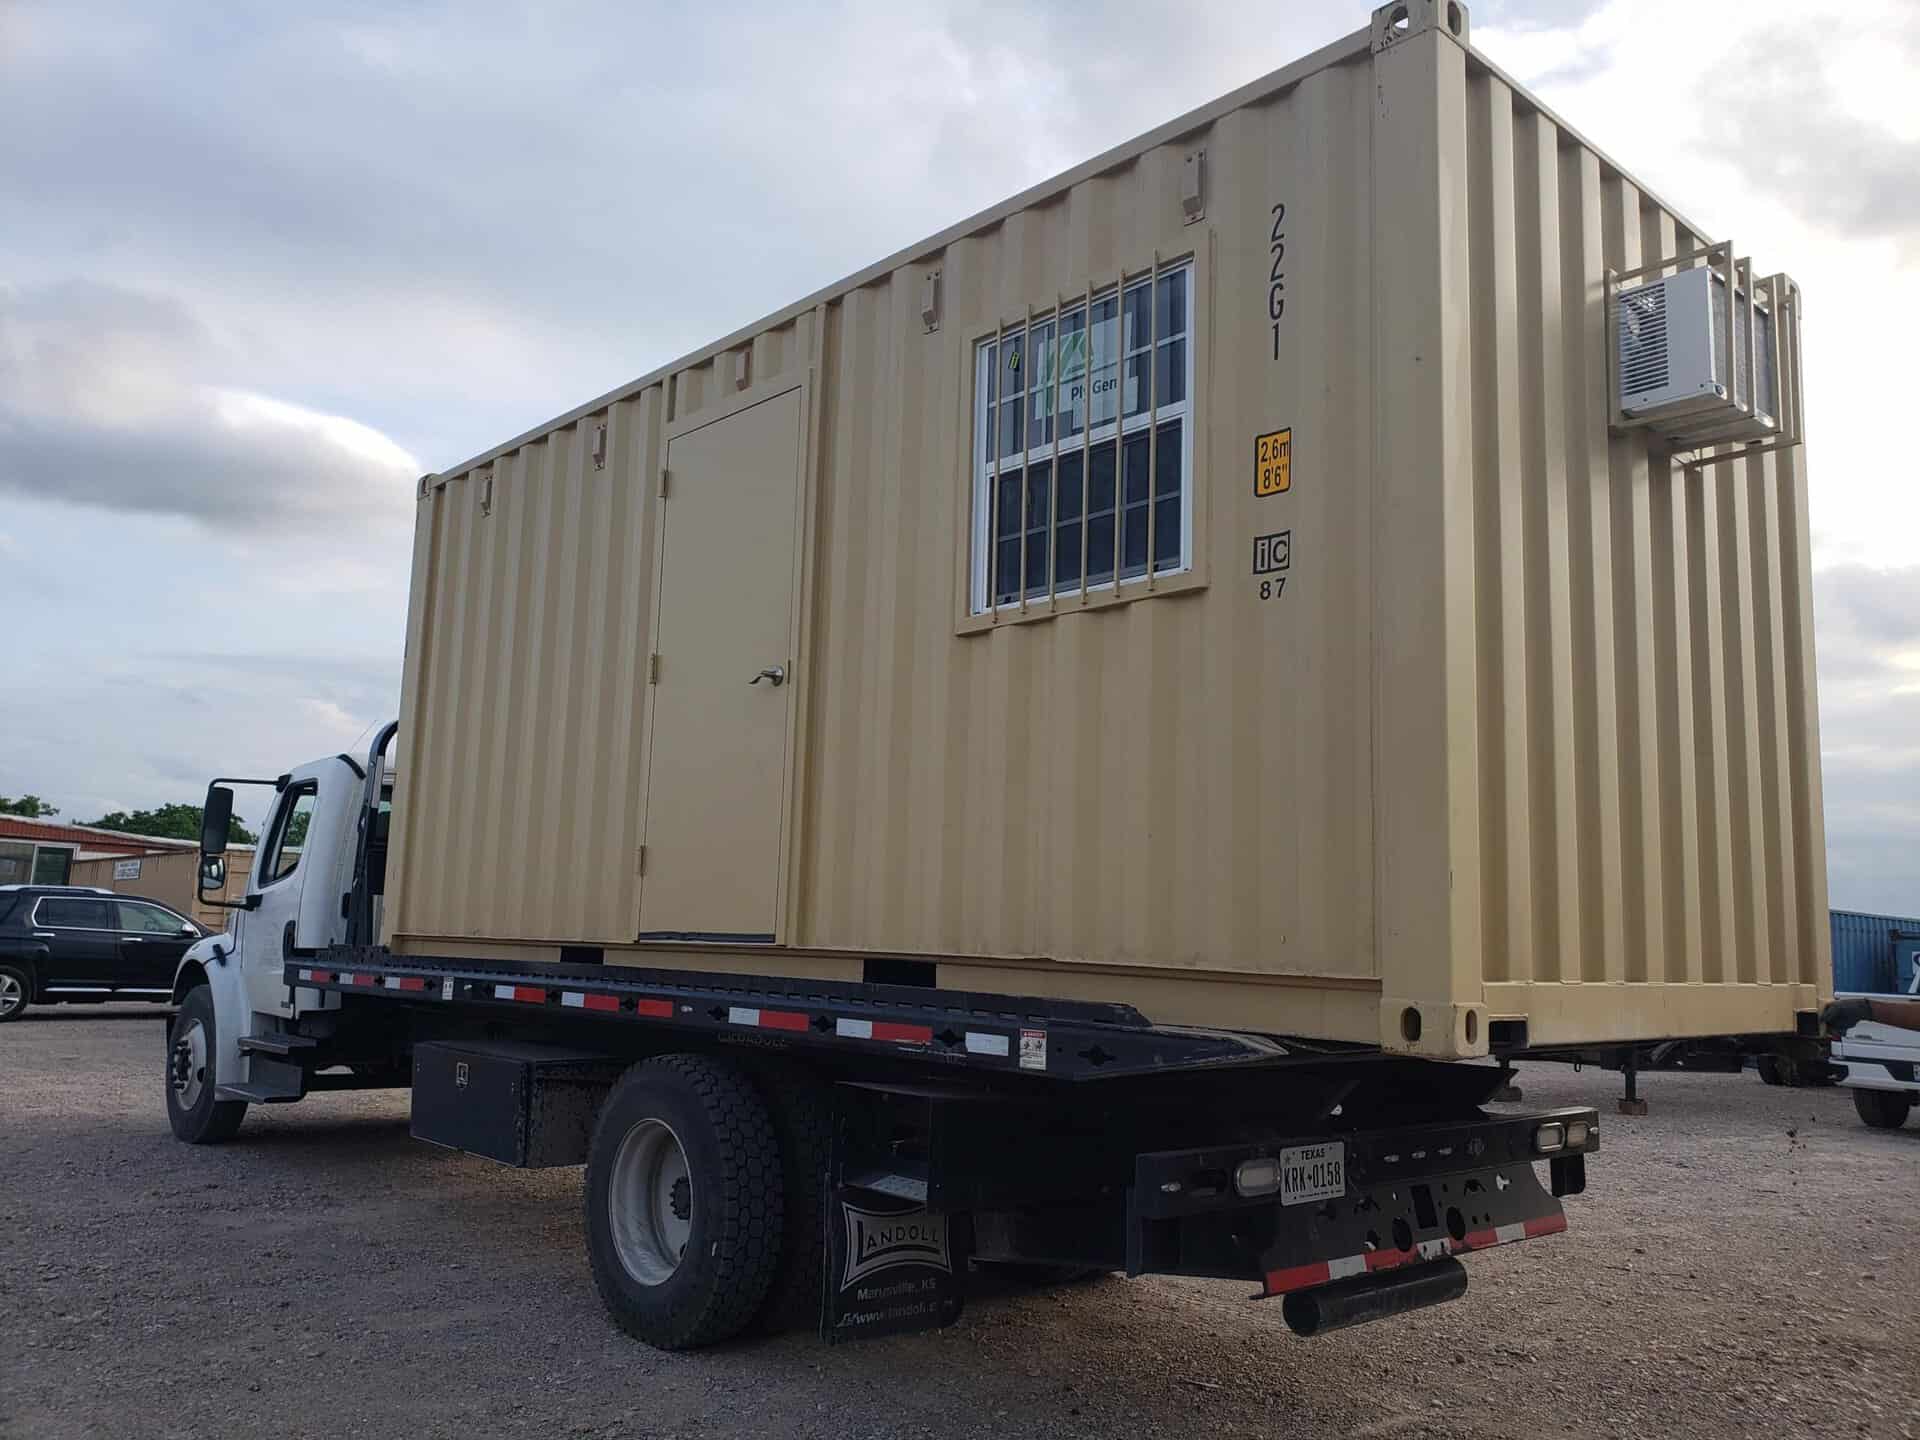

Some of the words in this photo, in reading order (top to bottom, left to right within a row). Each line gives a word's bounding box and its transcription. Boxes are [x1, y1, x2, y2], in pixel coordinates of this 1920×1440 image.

[1269, 203, 1285, 360] 22G1
[1259, 577, 1286, 600] 87
[1301, 1147, 1325, 1161] TEXAS
[856, 1220, 941, 1267] LANDOLL
